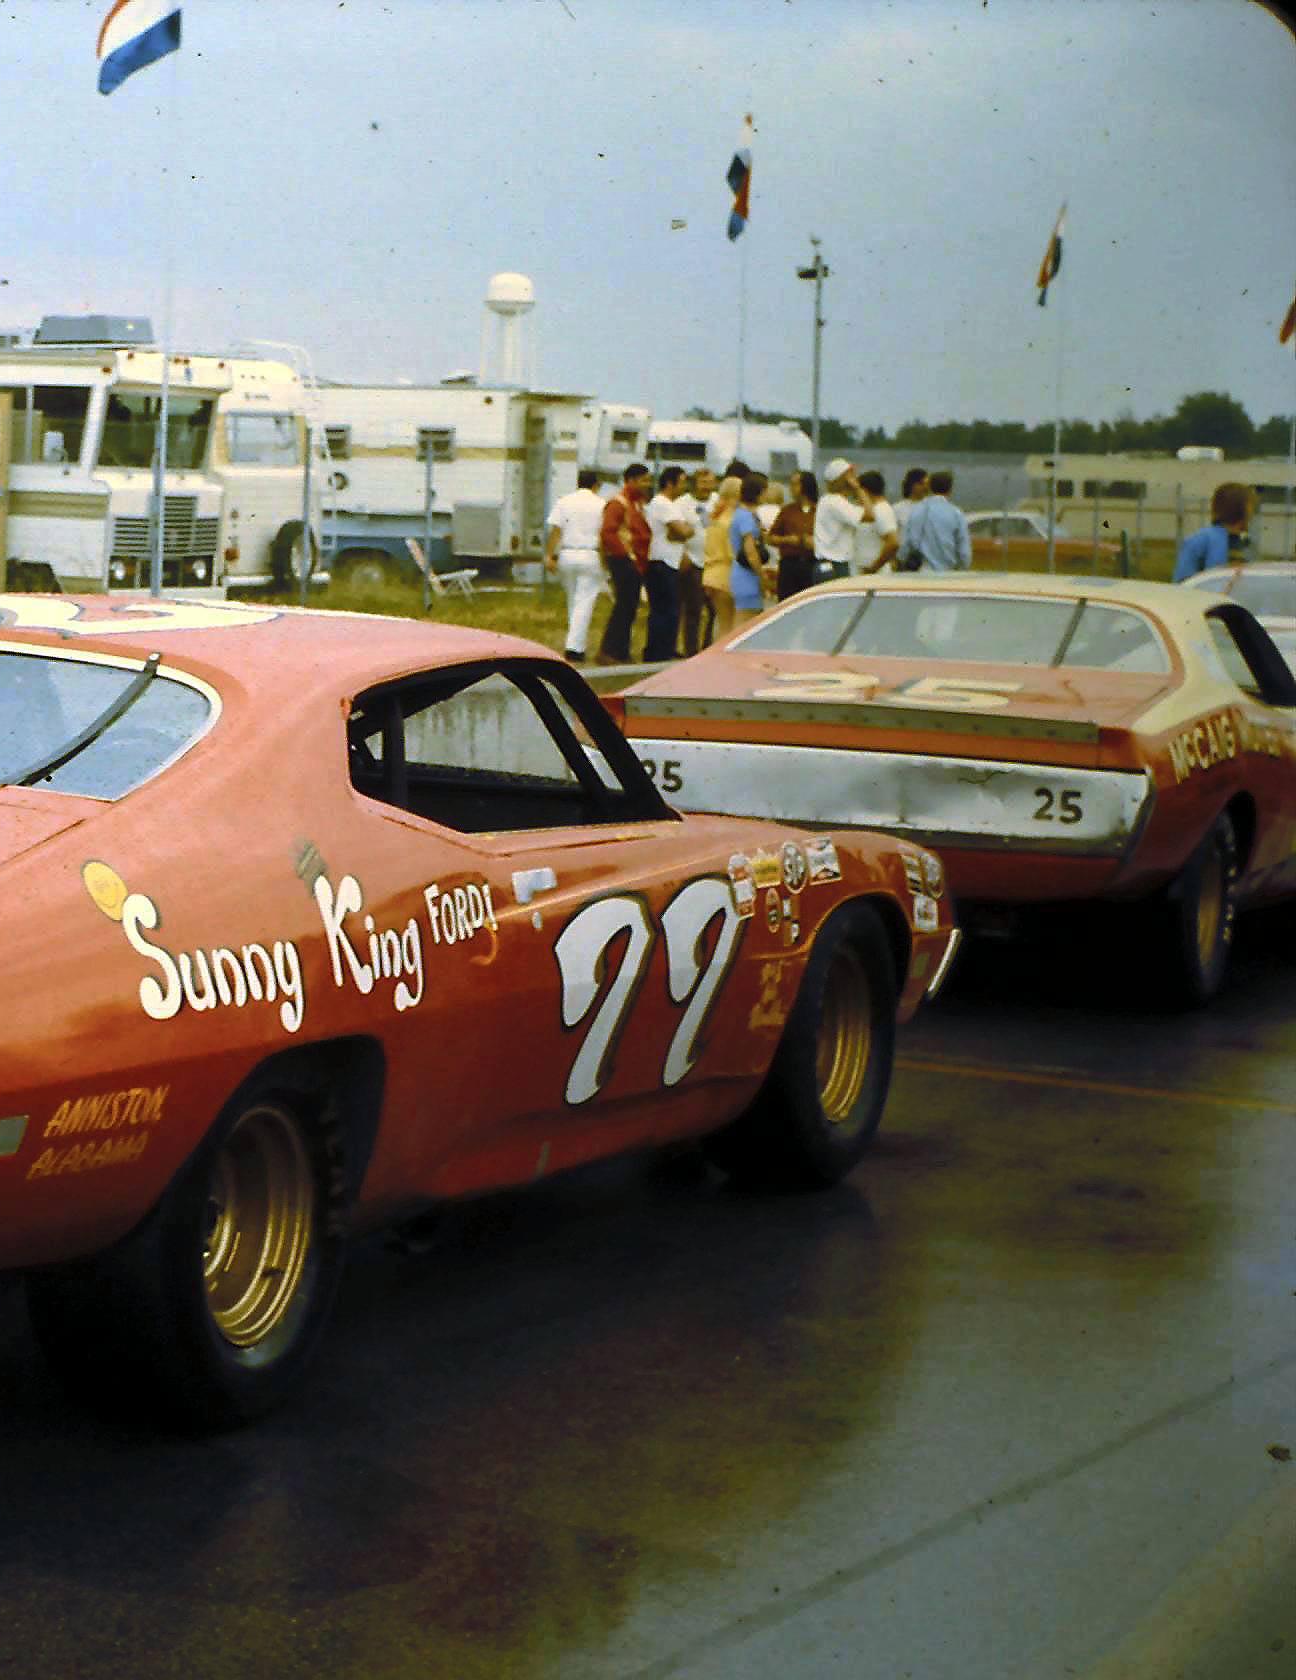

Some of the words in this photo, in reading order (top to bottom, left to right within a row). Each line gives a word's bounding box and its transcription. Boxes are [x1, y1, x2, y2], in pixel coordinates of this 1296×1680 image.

[1033, 787, 1083, 824] 25
[122, 892, 304, 1033] Sunny
[313, 874, 423, 1012] King
[554, 873, 750, 1106] 77
[43, 1084, 170, 1137] ANNISTON
